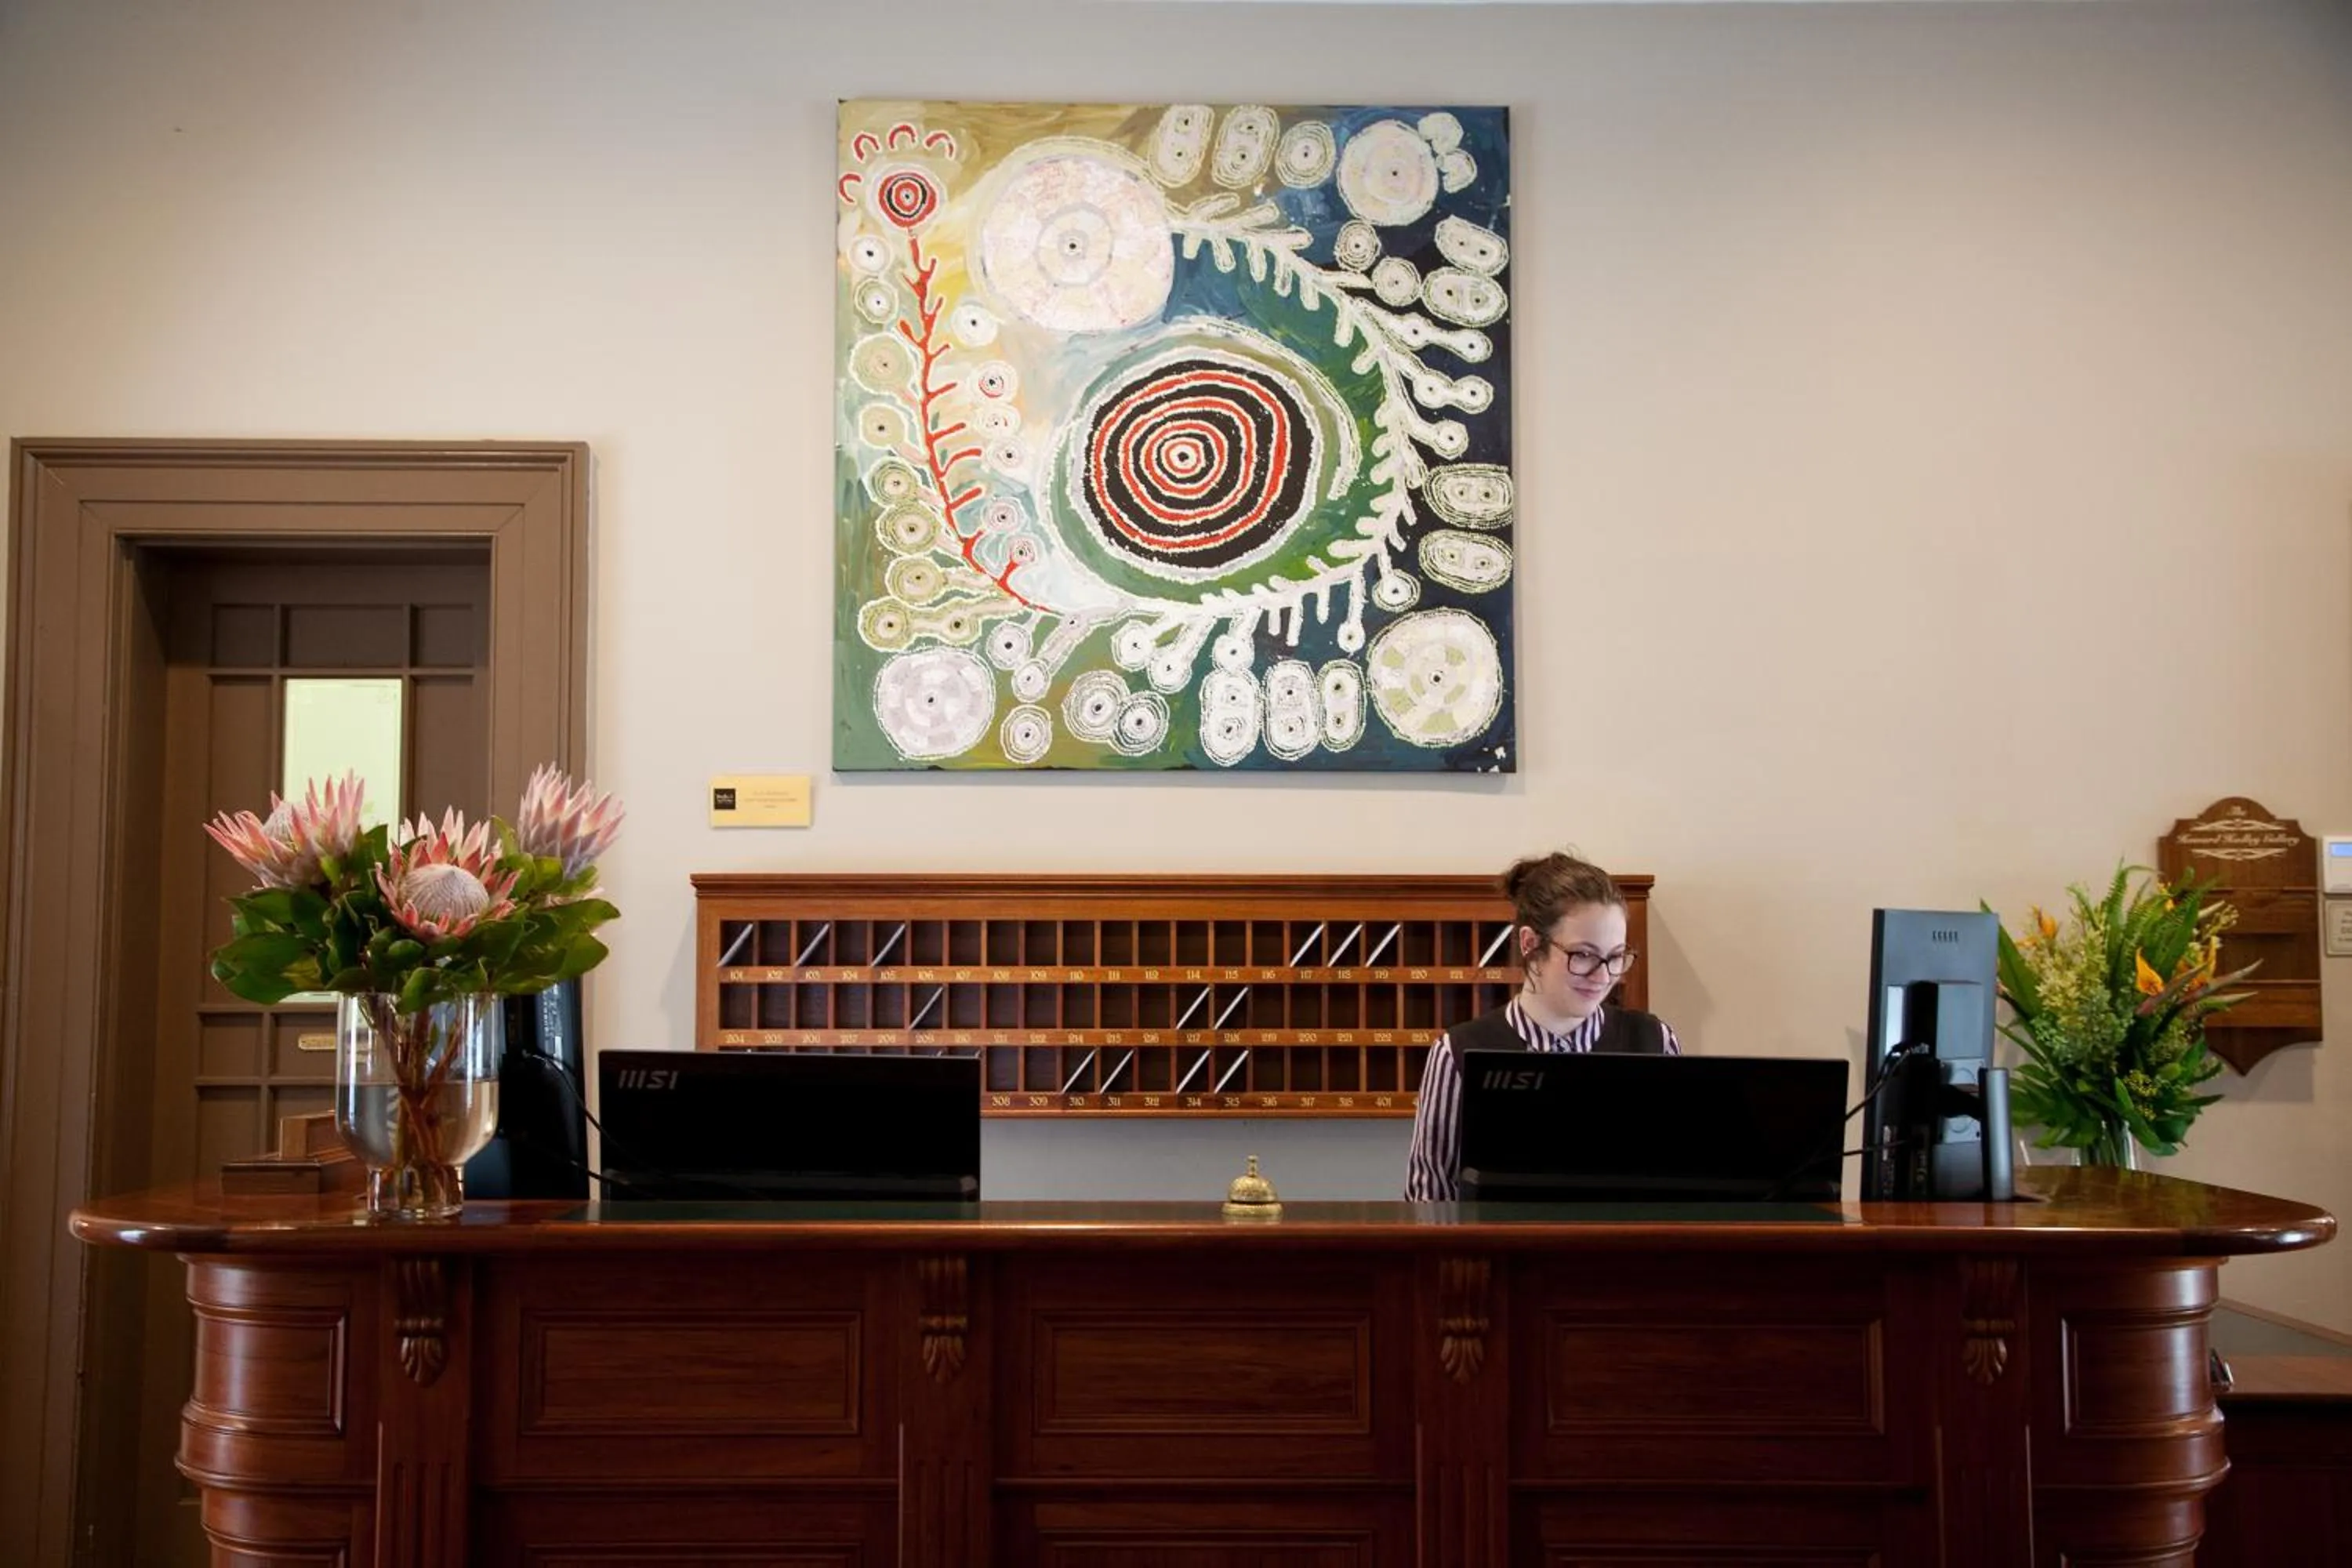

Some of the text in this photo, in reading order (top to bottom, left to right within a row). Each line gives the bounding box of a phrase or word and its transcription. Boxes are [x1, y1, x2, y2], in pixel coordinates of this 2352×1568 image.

[731, 970, 743, 980] 101
[768, 970, 782, 980] 102
[805, 970, 820, 980] 103
[843, 970, 858, 980] 104
[880, 970, 895, 980] 105
[918, 970, 934, 980] 106
[956, 970, 971, 980] 107
[993, 970, 1009, 980] 108
[1031, 970, 1047, 980] 109
[1070, 970, 1083, 980] 110
[1109, 970, 1120, 980] 111
[1145, 970, 1159, 980] 112
[1186, 970, 1200, 980] 114
[1225, 970, 1238, 980] 115
[1262, 970, 1276, 980] 116
[1301, 970, 1312, 980] 117
[1338, 970, 1351, 980] 118
[1374, 970, 1388, 980] 119
[1410, 970, 1427, 980] 120
[727, 1033, 744, 1044] 204
[840, 1033, 858, 1044] 207
[878, 1033, 896, 1044] 208
[955, 1033, 971, 1044] 210
[993, 1033, 1007, 1044] 211
[1068, 1033, 1083, 1044] 214
[1106, 1033, 1121, 1044] 215
[1186, 1033, 1200, 1044] 217
[1261, 1033, 1276, 1044] 219
[1298, 1033, 1316, 1044] 220
[1337, 1033, 1352, 1044] 221
[1374, 1033, 1392, 1044] 222
[618, 1069, 680, 1090] MSI
[1483, 1070, 1545, 1091] MSI
[992, 1097, 1010, 1106] 308
[1029, 1097, 1047, 1106] 309
[1069, 1097, 1084, 1106] 310
[1109, 1097, 1120, 1106] 311
[1145, 1097, 1159, 1106] 312
[1187, 1097, 1201, 1106] 314
[1262, 1097, 1276, 1106] 316
[1301, 1097, 1315, 1106] 317
[1376, 1097, 1391, 1106] 401
